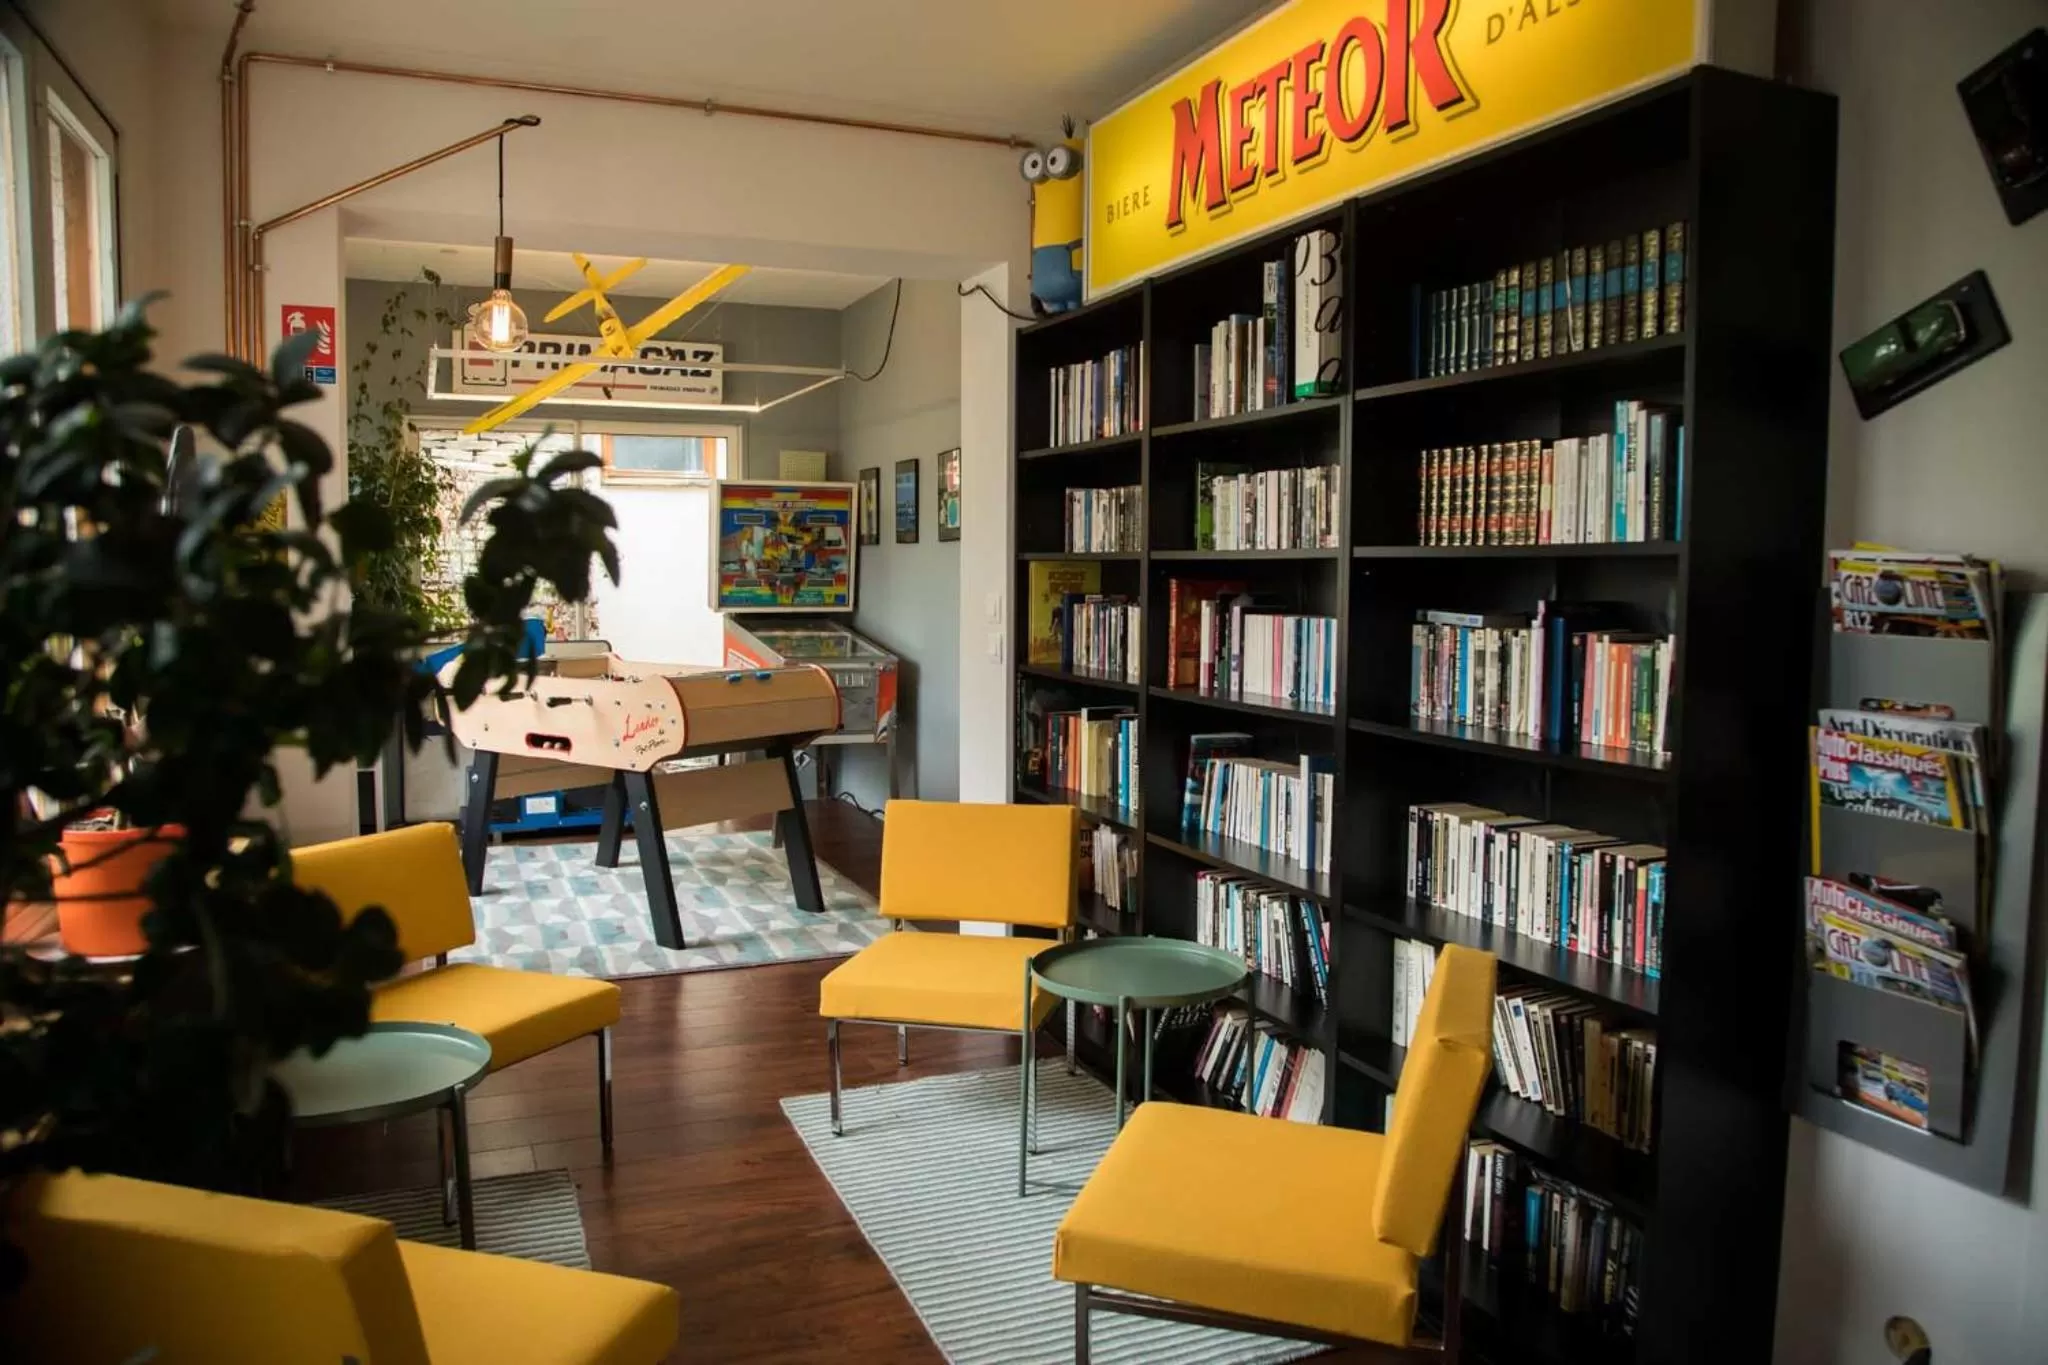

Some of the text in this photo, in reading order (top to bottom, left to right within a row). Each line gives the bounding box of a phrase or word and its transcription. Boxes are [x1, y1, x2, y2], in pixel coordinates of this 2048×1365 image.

[1486, 0, 1582, 45] D'AL
[1165, 0, 1477, 233] METEOR
[1105, 186, 1152, 223] BIERE
[1843, 610, 1874, 630] R12
[1846, 740, 1946, 778] Classiques
